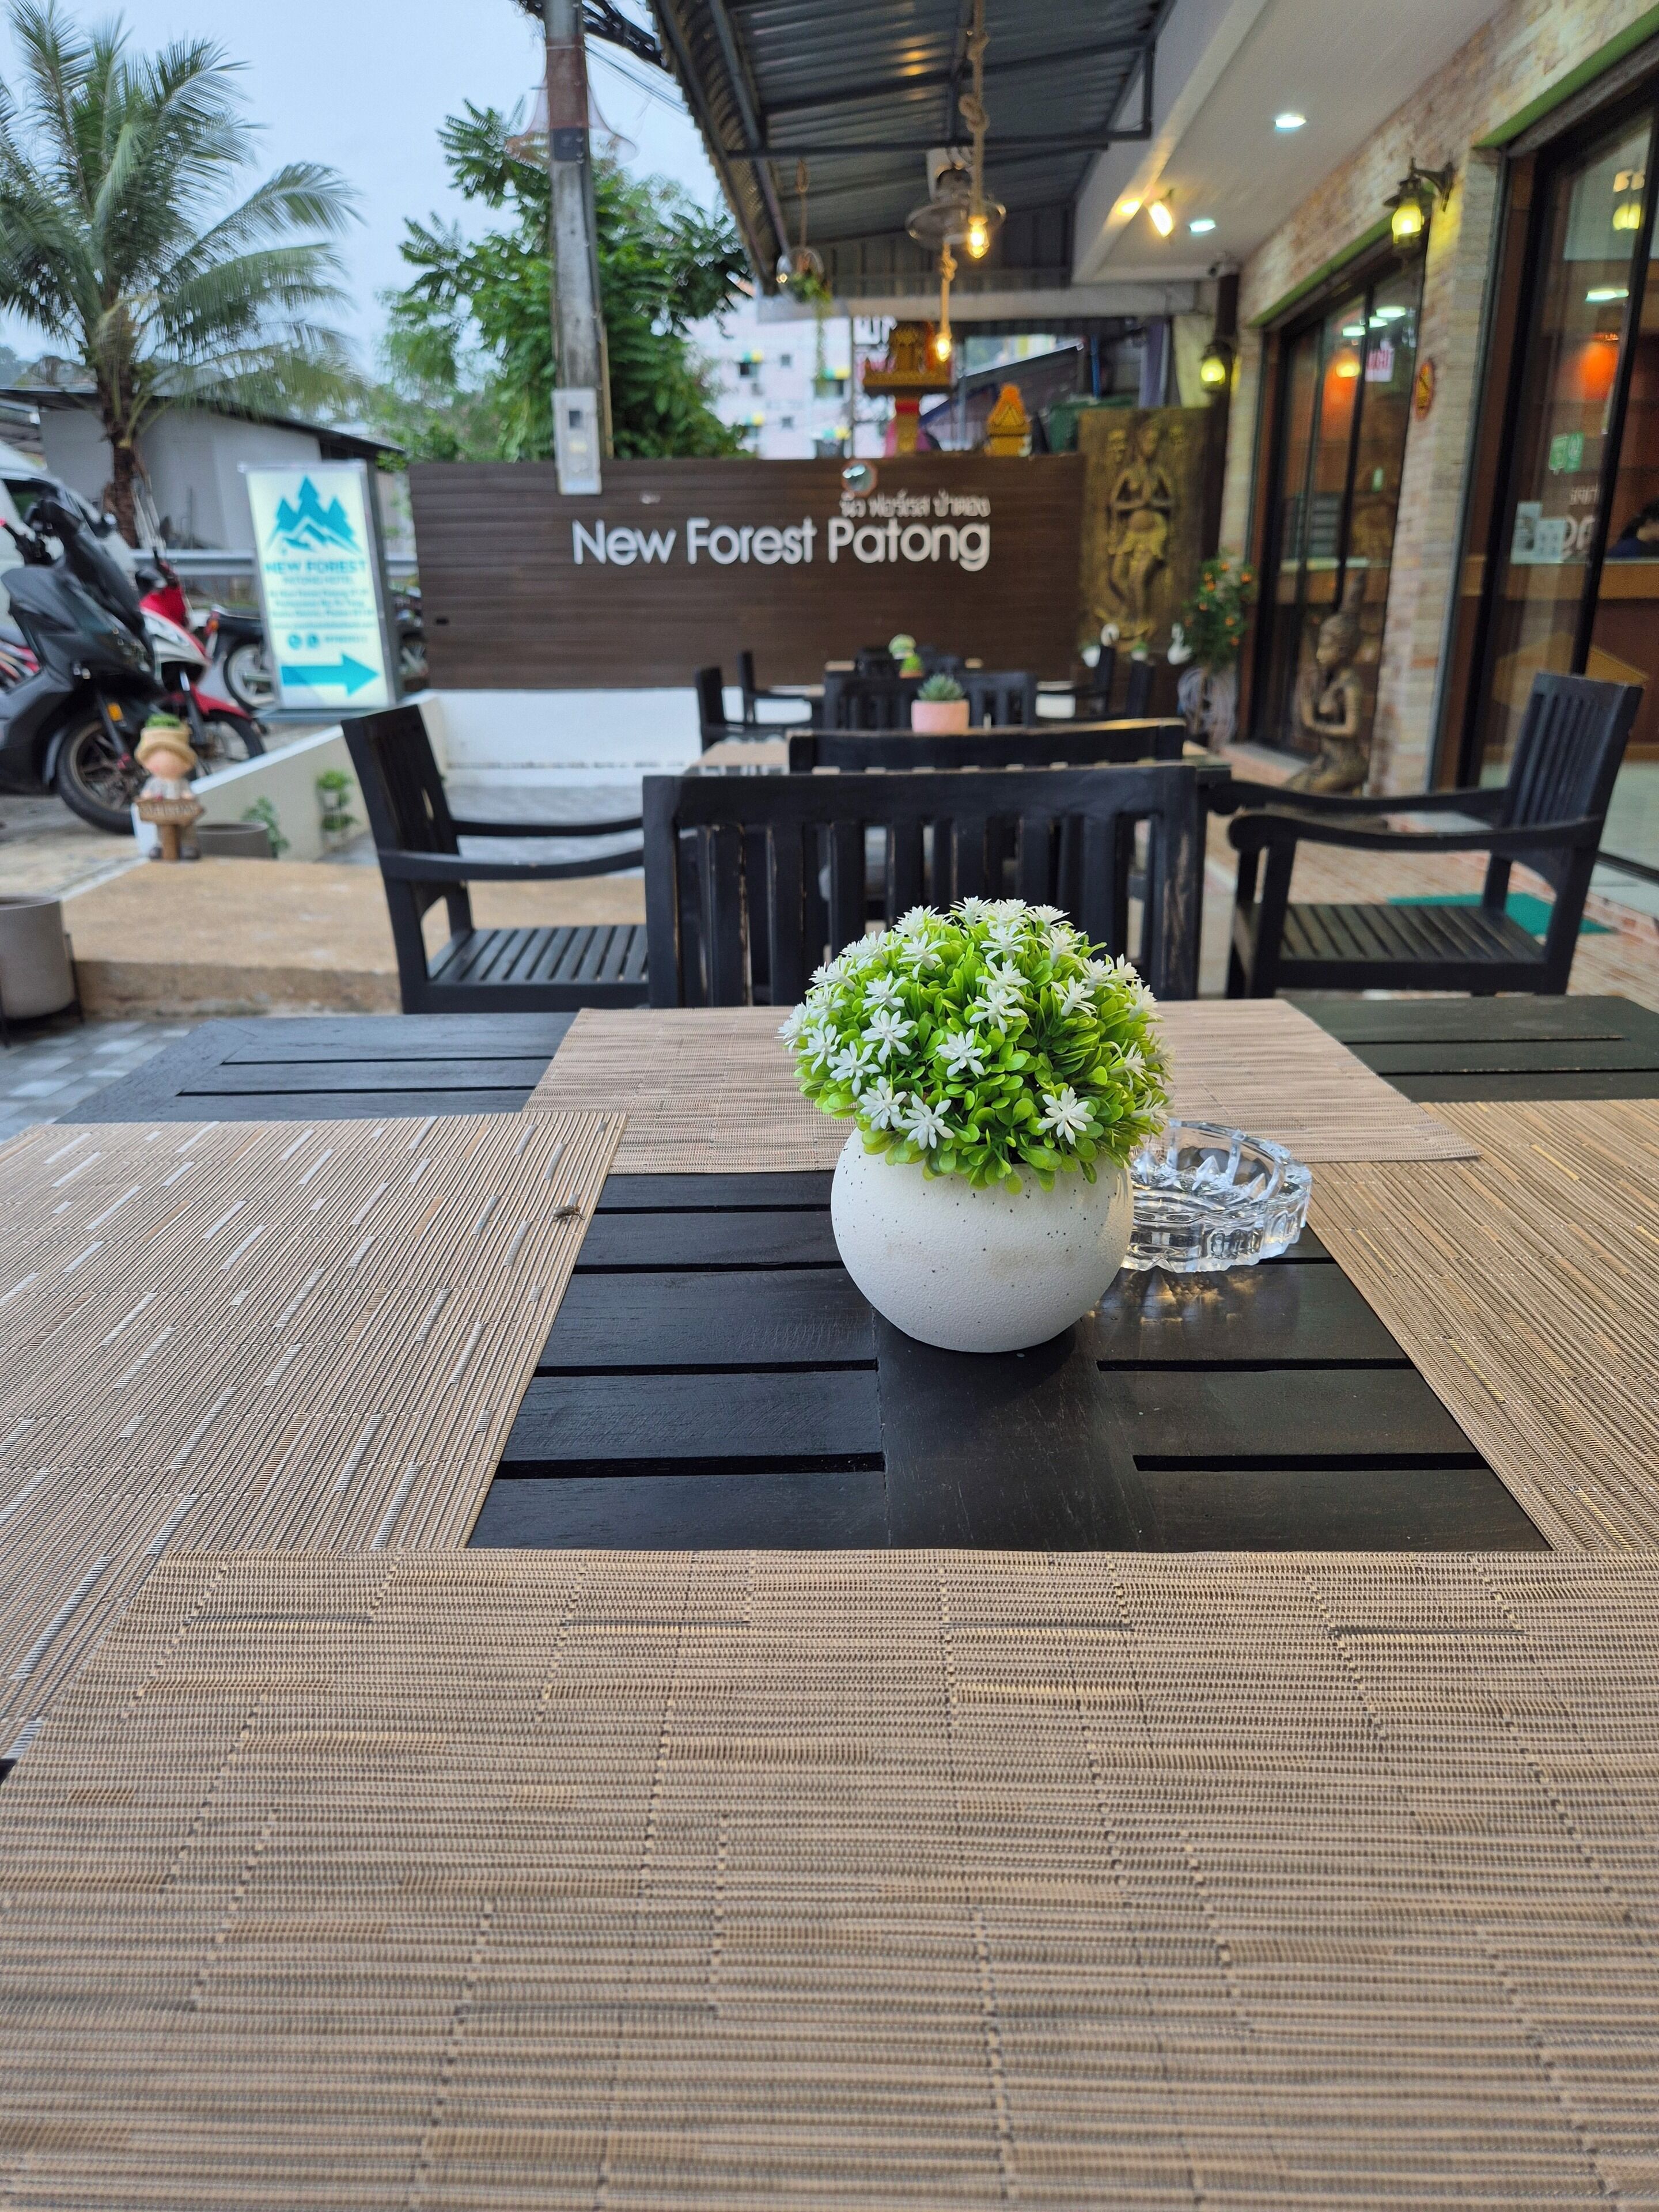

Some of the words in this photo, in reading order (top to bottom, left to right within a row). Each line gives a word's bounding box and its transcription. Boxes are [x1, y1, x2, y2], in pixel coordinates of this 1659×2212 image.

[571, 517, 676, 565] New
[687, 517, 817, 565] Forest
[828, 516, 991, 572] Patong
[306, 559, 366, 573] FOREST
